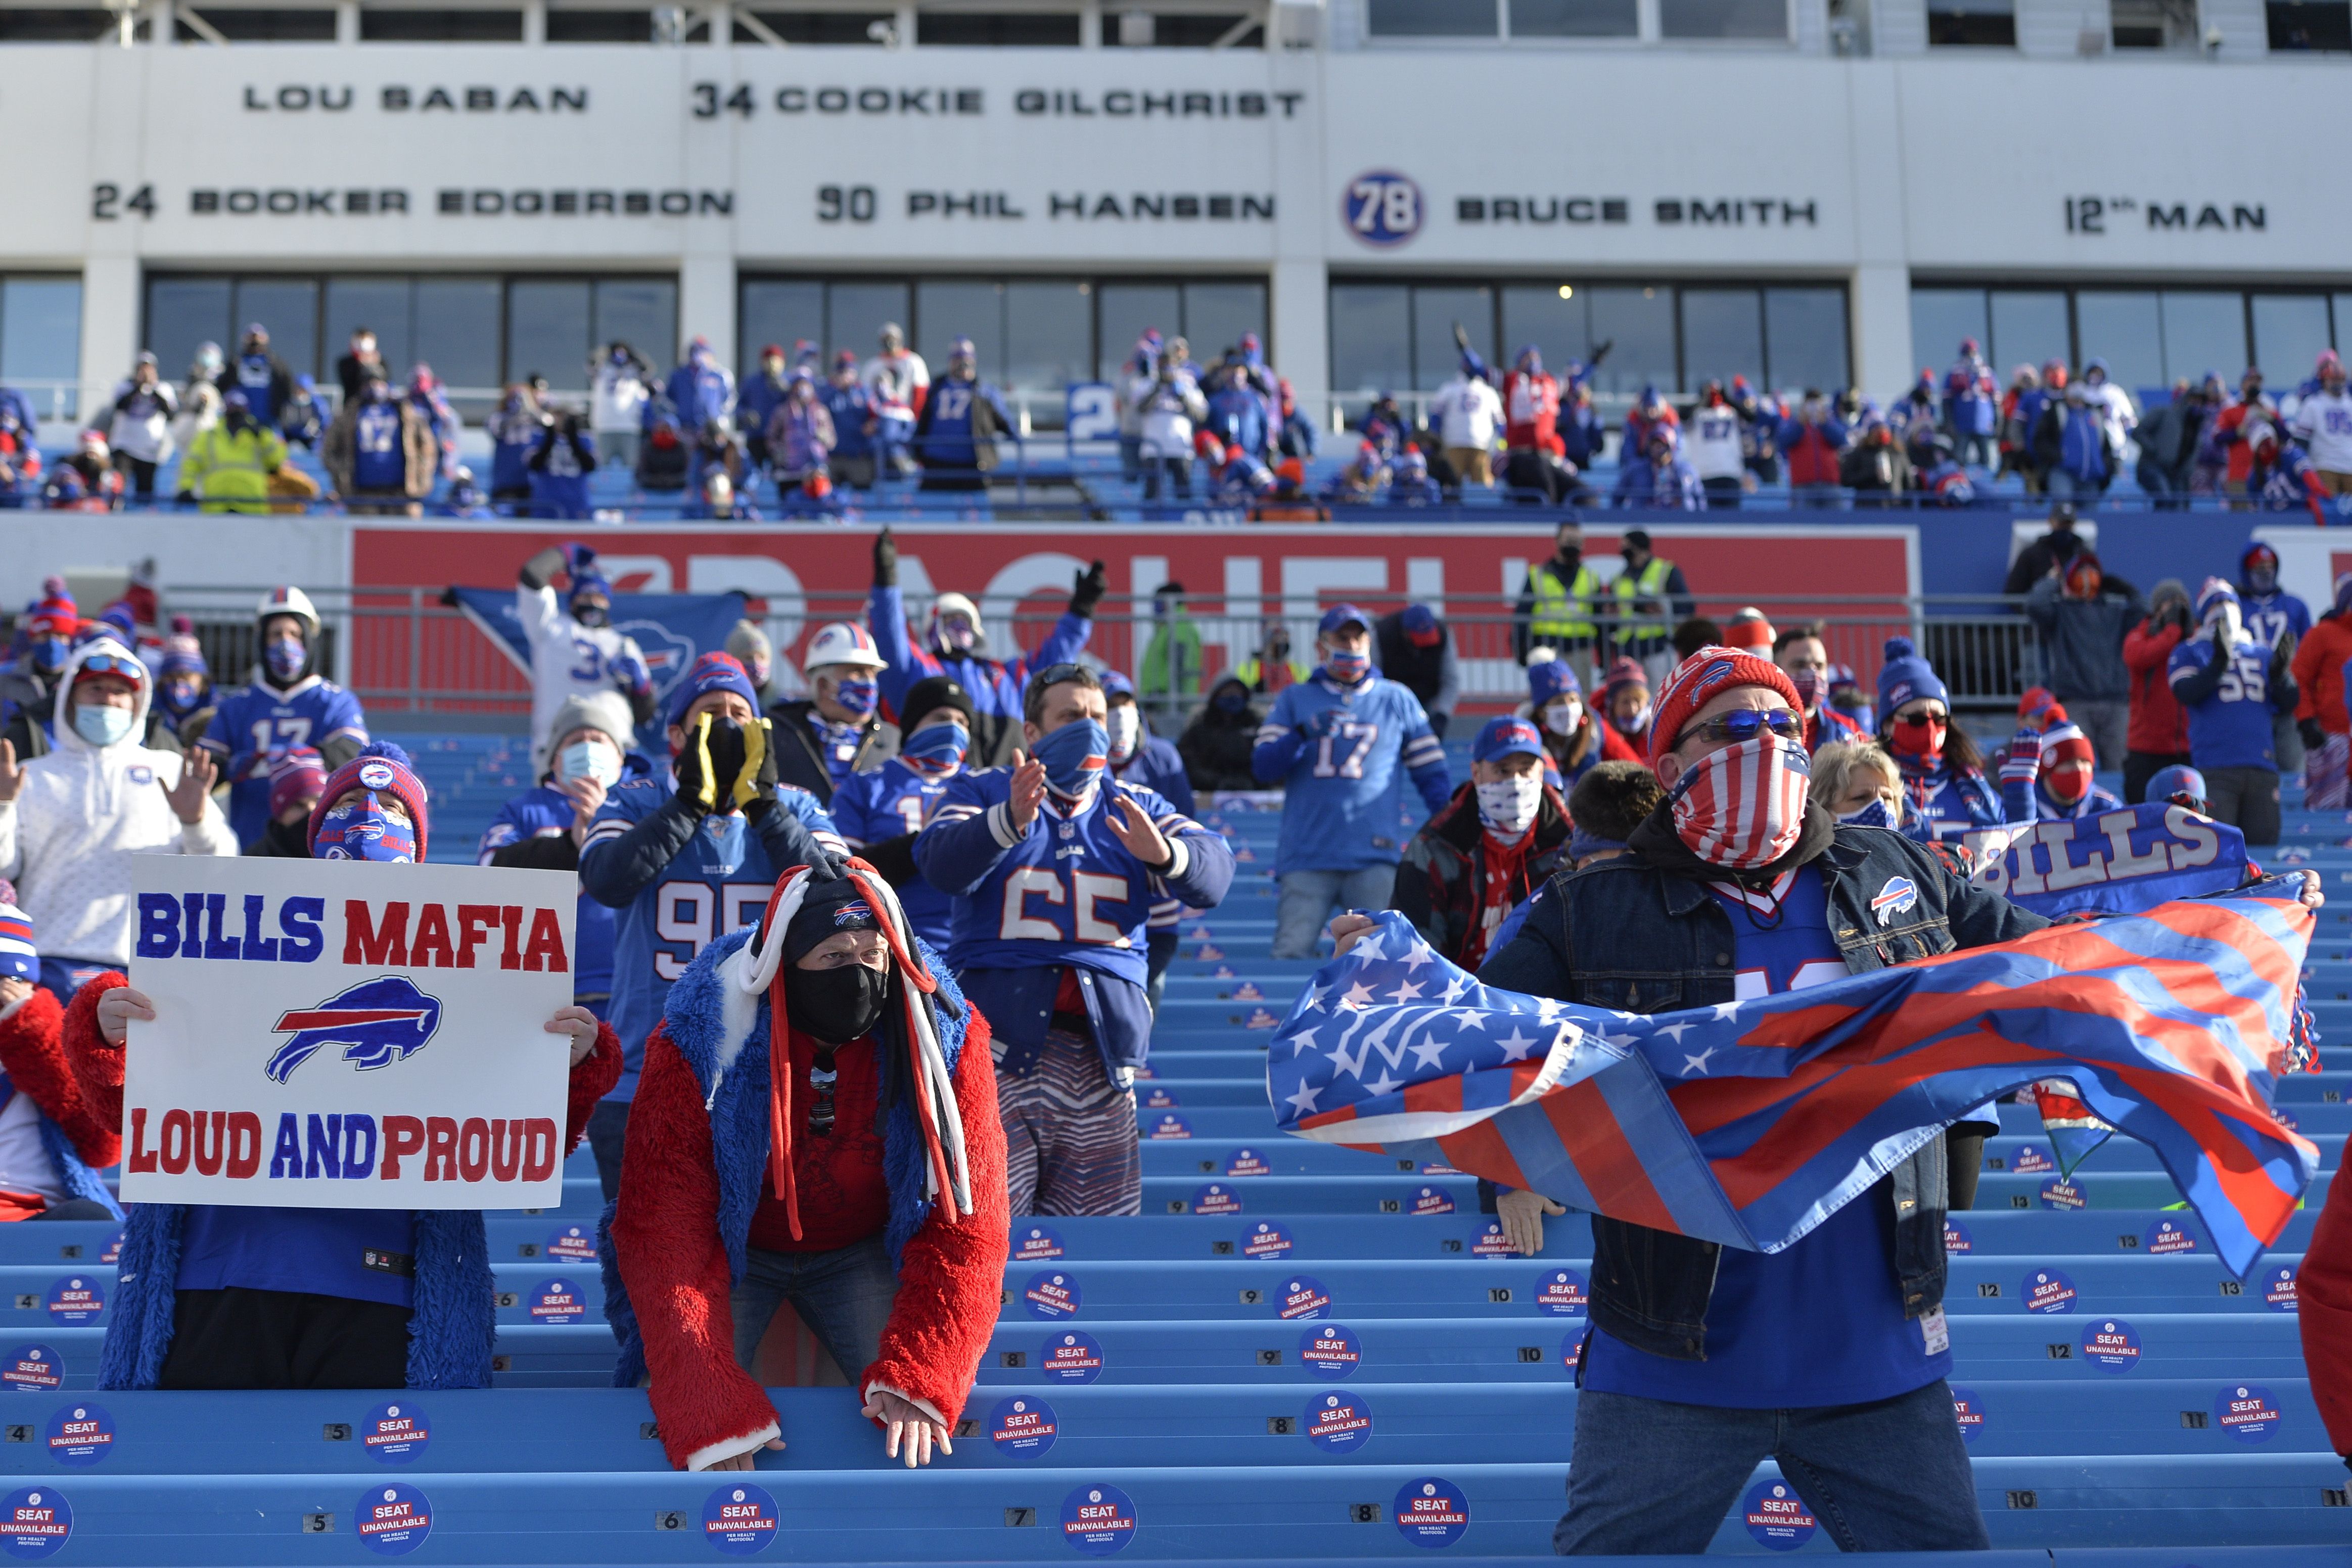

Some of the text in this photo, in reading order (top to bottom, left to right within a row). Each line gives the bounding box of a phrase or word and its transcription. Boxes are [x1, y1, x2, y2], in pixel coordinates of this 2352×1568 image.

[243, 85, 589, 114] LOU SABAN
[692, 81, 1306, 120] 34 COOKIE GILCHRIST
[91, 183, 158, 221] 24
[189, 189, 410, 216] BOOKER
[817, 185, 1277, 224] 90 PHIL HANSEN
[1353, 182, 1416, 233] 78
[1455, 197, 1817, 226] BRUCE SMITH
[2146, 203, 2267, 230] MAN
[2249, 610, 2288, 652] 17
[2219, 658, 2266, 703] 55
[1313, 723, 1378, 779] 17
[383, 835, 413, 854] BILLS
[1963, 804, 2219, 897] BILLS
[136, 893, 568, 973] BILLS MAFIA
[129, 1109, 557, 1182] LOUD AND PROUD
[2053, 1185, 2075, 1195] SEAT
[1174, 1202, 1182, 1212] 9
[1383, 1201, 1397, 1211] 10
[1418, 1197, 1439, 1208] SEAT
[2013, 1196, 2027, 1207] 13
[561, 1238, 586, 1247] SEAT
[1254, 1233, 1277, 1243] SEAT
[2120, 1236, 2136, 1248] 13
[2158, 1232, 2180, 1242] SEAT
[1026, 1240, 1049, 1249] SEAT
[1219, 1243, 1228, 1253] 9
[1246, 1242, 1289, 1253] UNAVAILABLE
[2151, 1241, 2193, 1252] UNAVAILABLE
[1017, 1249, 1061, 1258] UNAVAILABLE
[1041, 1284, 1068, 1299] SEAT
[1550, 1285, 1575, 1294] SEAT
[1981, 1285, 1998, 1296] 12
[2035, 1282, 2059, 1297] SEAT
[2222, 1283, 2240, 1295] 13
[2276, 1282, 2296, 1292] SEA
[22, 1296, 32, 1307] 4
[63, 1292, 89, 1300] SEAT
[501, 1294, 511, 1306] 6
[544, 1296, 570, 1304] SEAT
[1028, 1292, 1074, 1311] UNAVAILABLE
[1246, 1290, 1256, 1302] 9
[1287, 1290, 1312, 1306] SEAT
[1493, 1289, 1508, 1302] 10
[2029, 1290, 2073, 1308] UNAVAILABLE
[2268, 1293, 2299, 1302] UNAVAIL
[1282, 1297, 1327, 1317] UNAVAILABLE
[1316, 1341, 1344, 1350] SEAT
[2098, 1335, 2125, 1344] SEAT
[1057, 1348, 1085, 1358] SEAT
[1523, 1349, 1540, 1361] 10
[2050, 1345, 2069, 1358] 12
[2087, 1346, 2136, 1354] UNAVAILABLE
[1007, 1354, 1018, 1366] 8
[1264, 1351, 1275, 1364] 9
[18, 1362, 48, 1373] SEAT
[1046, 1360, 1098, 1368] UNAVAILABLE
[5, 1373, 57, 1383] UNAVAILABLE
[2231, 1400, 2260, 1412] SEAT
[1007, 1414, 1037, 1427] SEAT
[1321, 1408, 1350, 1422] SEAT
[2187, 1413, 2203, 1427] 11
[2222, 1412, 2276, 1423] UNAVAILABLE
[65, 1422, 96, 1434] SEAT
[380, 1419, 410, 1432] SEAT
[963, 1422, 972, 1436] 7
[1276, 1418, 1287, 1434] 8
[1311, 1419, 1367, 1435] UNAVAILABLE
[13, 1426, 25, 1441] 4
[332, 1426, 344, 1439] 5
[367, 1432, 425, 1444] UNAVAILABLE
[996, 1426, 1052, 1439] UNAVAILABLE
[52, 1435, 109, 1445] UNAVAILABLE
[1414, 1500, 1447, 1510] SEAT
[2012, 1493, 2033, 1507] 10
[376, 1504, 409, 1518] SEAT
[723, 1506, 757, 1517] SEAT
[1081, 1506, 1114, 1518] SEAT
[1359, 1505, 1371, 1520] 8
[1764, 1501, 1797, 1512] SEAT
[16, 1510, 52, 1520] SEAT
[665, 1513, 678, 1529] 6
[1015, 1510, 1027, 1525] 7
[1750, 1515, 1811, 1525] UNAVAILABLE
[1, 1525, 64, 1533] UNAVAILABLE
[312, 1515, 326, 1532] 5
[362, 1517, 426, 1532] UNAVAILABLE
[709, 1520, 772, 1530] UNAVAILABLE
[1068, 1520, 1130, 1531] UNAVAILABLE
